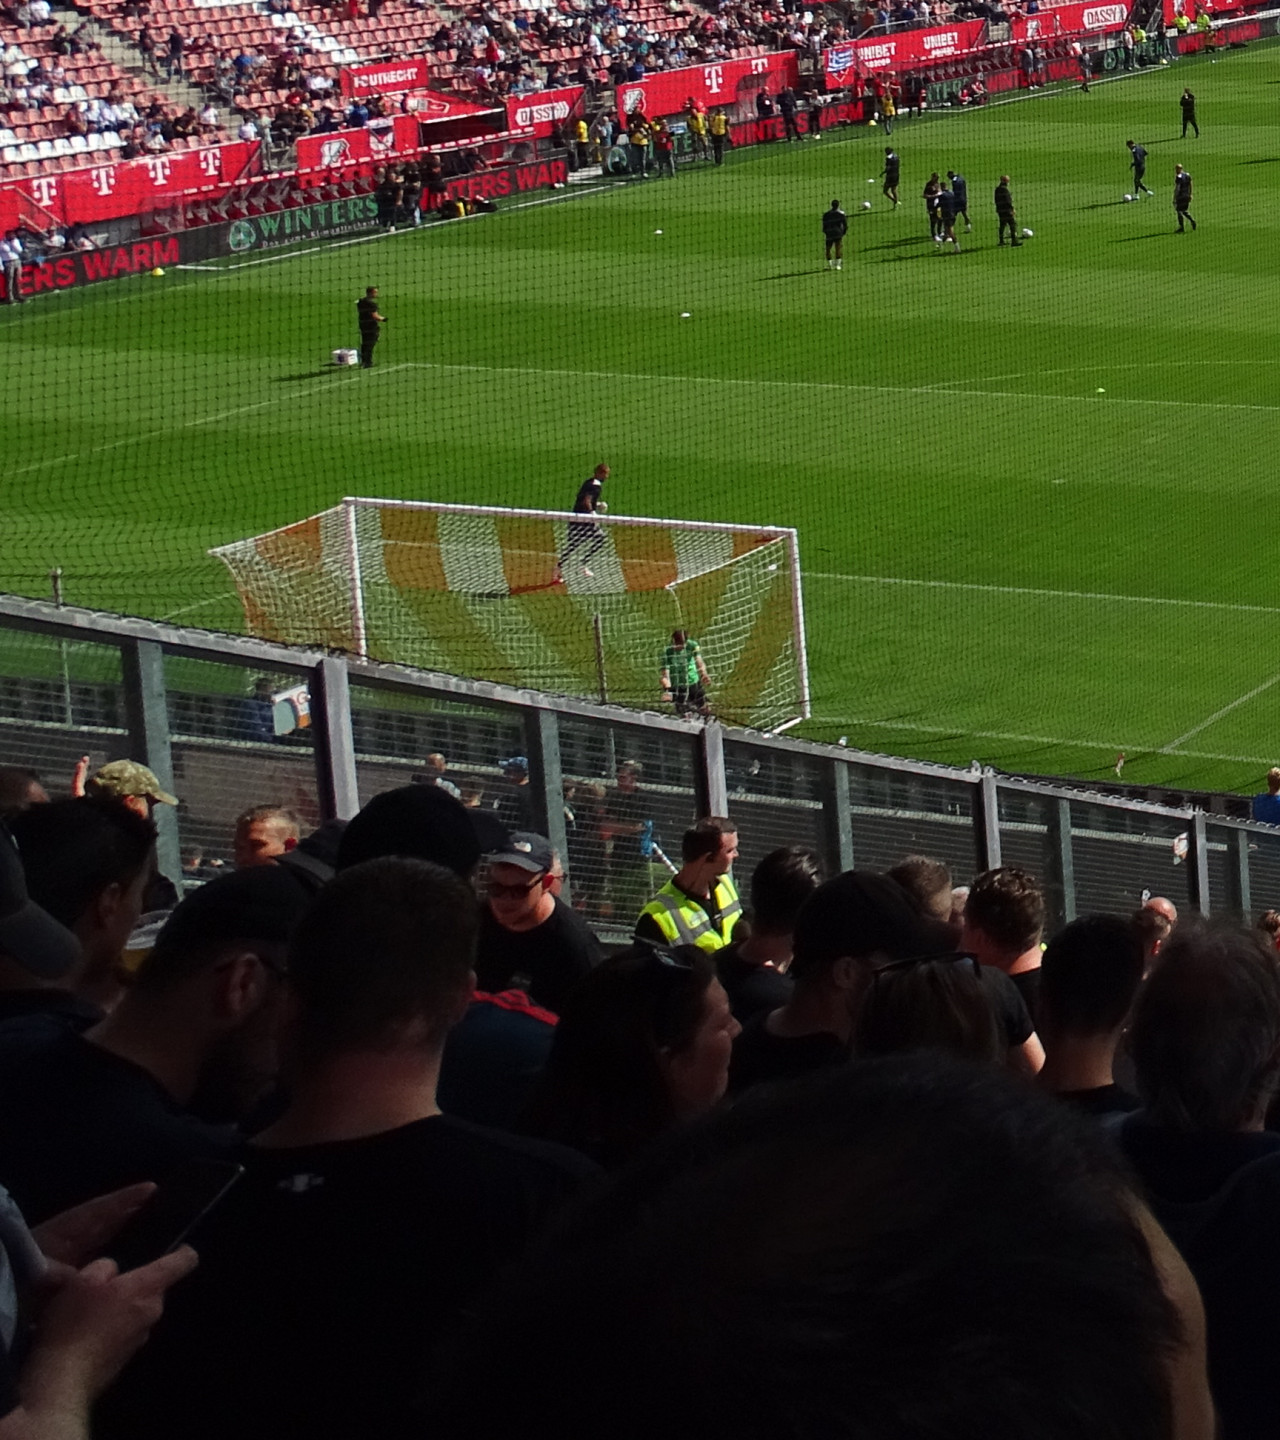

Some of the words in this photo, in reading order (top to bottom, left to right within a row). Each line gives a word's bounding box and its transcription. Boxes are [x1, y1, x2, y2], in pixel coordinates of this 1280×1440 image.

[1086, 6, 1118, 28] DASSY
[922, 31, 959, 49] UNIBET
[368, 67, 418, 86] UTRECHT
[729, 113, 809, 148] WINTES
[257, 193, 380, 237] WINTERS
[81, 237, 180, 278] WARM
